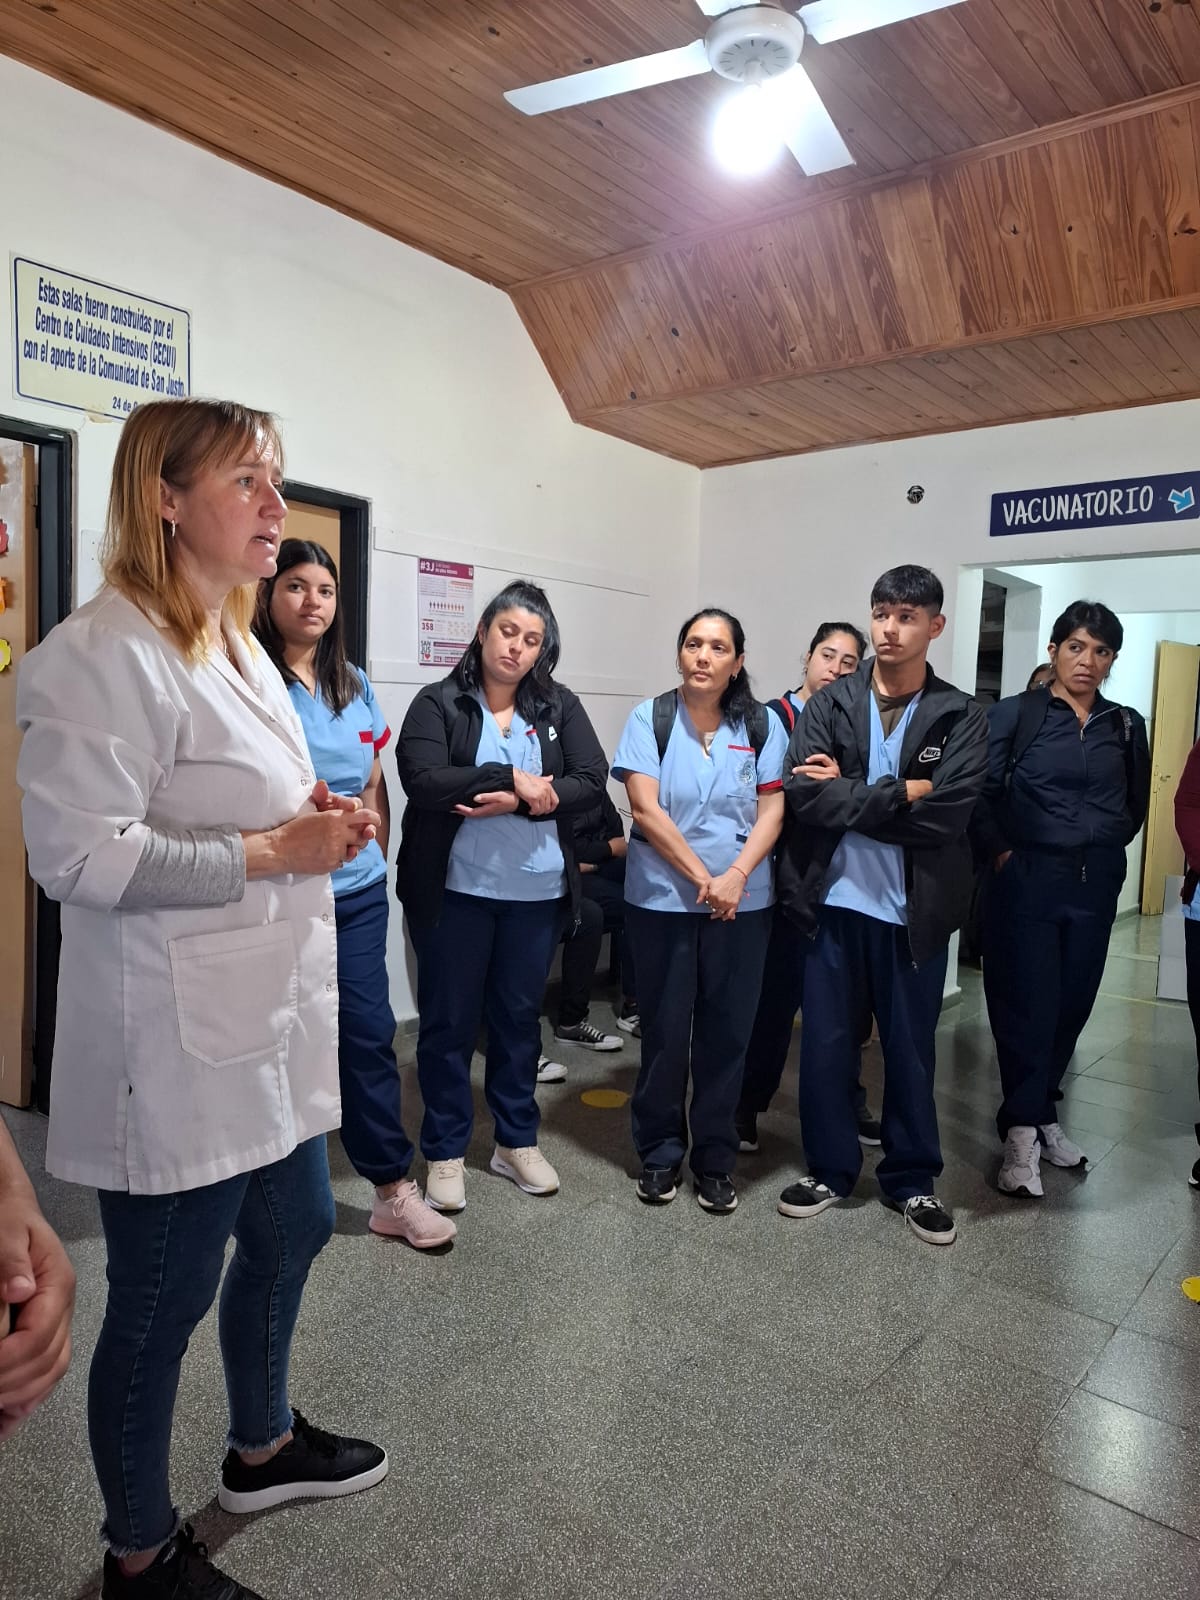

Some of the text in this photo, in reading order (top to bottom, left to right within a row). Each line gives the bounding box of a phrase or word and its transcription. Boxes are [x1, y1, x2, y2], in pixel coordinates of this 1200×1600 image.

[38, 277, 173, 343] Estas salas fueron construidas por el
[24, 339, 38, 360] con
[41, 340, 48, 362] el
[51, 347, 74, 371] aporte
[78, 349, 86, 373] de
[89, 352, 96, 375] la
[99, 354, 139, 385] Comunidad
[141, 366, 149, 389] de
[151, 369, 164, 393] San
[36, 306, 176, 373] Centro de Cuidados Intensivos (CECUI)
[113, 396, 121, 409] 24
[123, 399, 130, 412] de
[1002, 484, 1154, 526] VACUNATORIO
